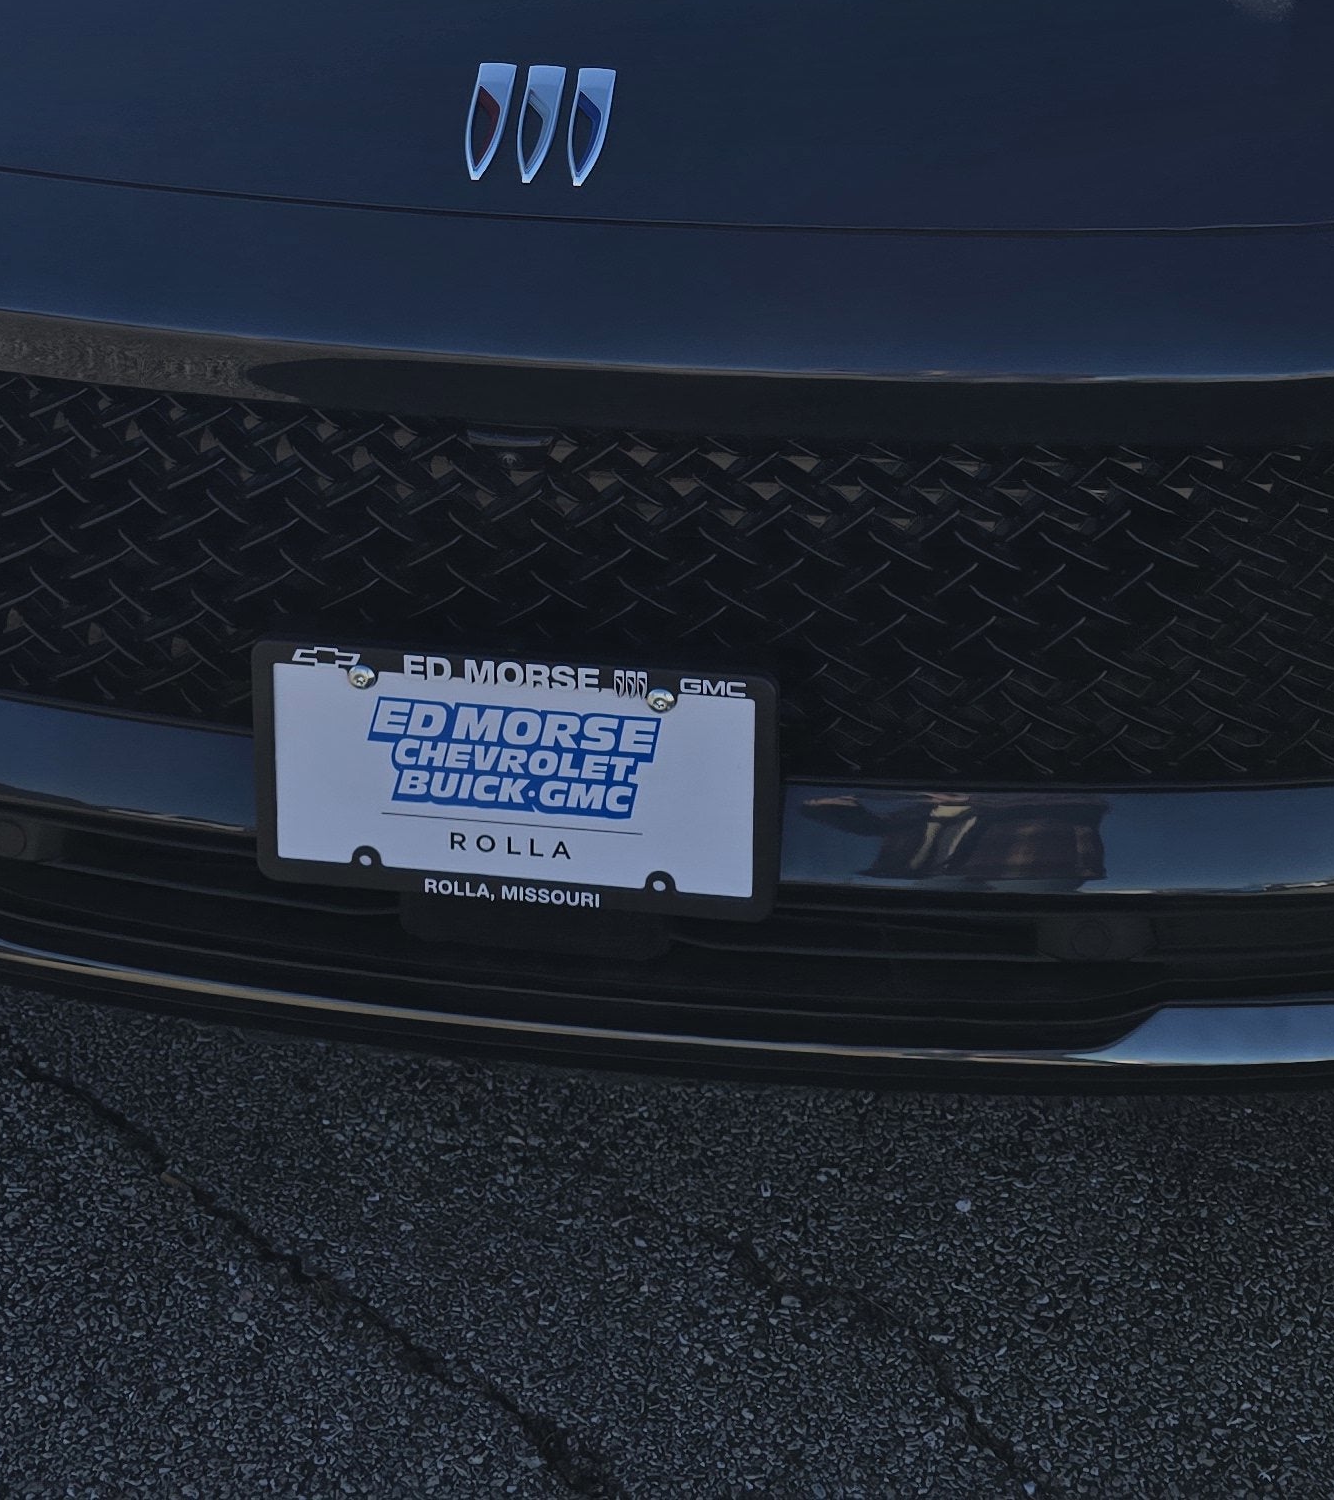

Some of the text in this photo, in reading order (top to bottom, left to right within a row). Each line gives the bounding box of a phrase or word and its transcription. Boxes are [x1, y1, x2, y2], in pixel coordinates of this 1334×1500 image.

[403, 654, 600, 692] ED MORSE
[680, 678, 747, 697] GMC
[373, 700, 658, 754] ED MORSE
[394, 739, 635, 781] CHEVROLET
[450, 832, 571, 859] ROLLA
[424, 878, 600, 908] ROLLA, MISSOURI
